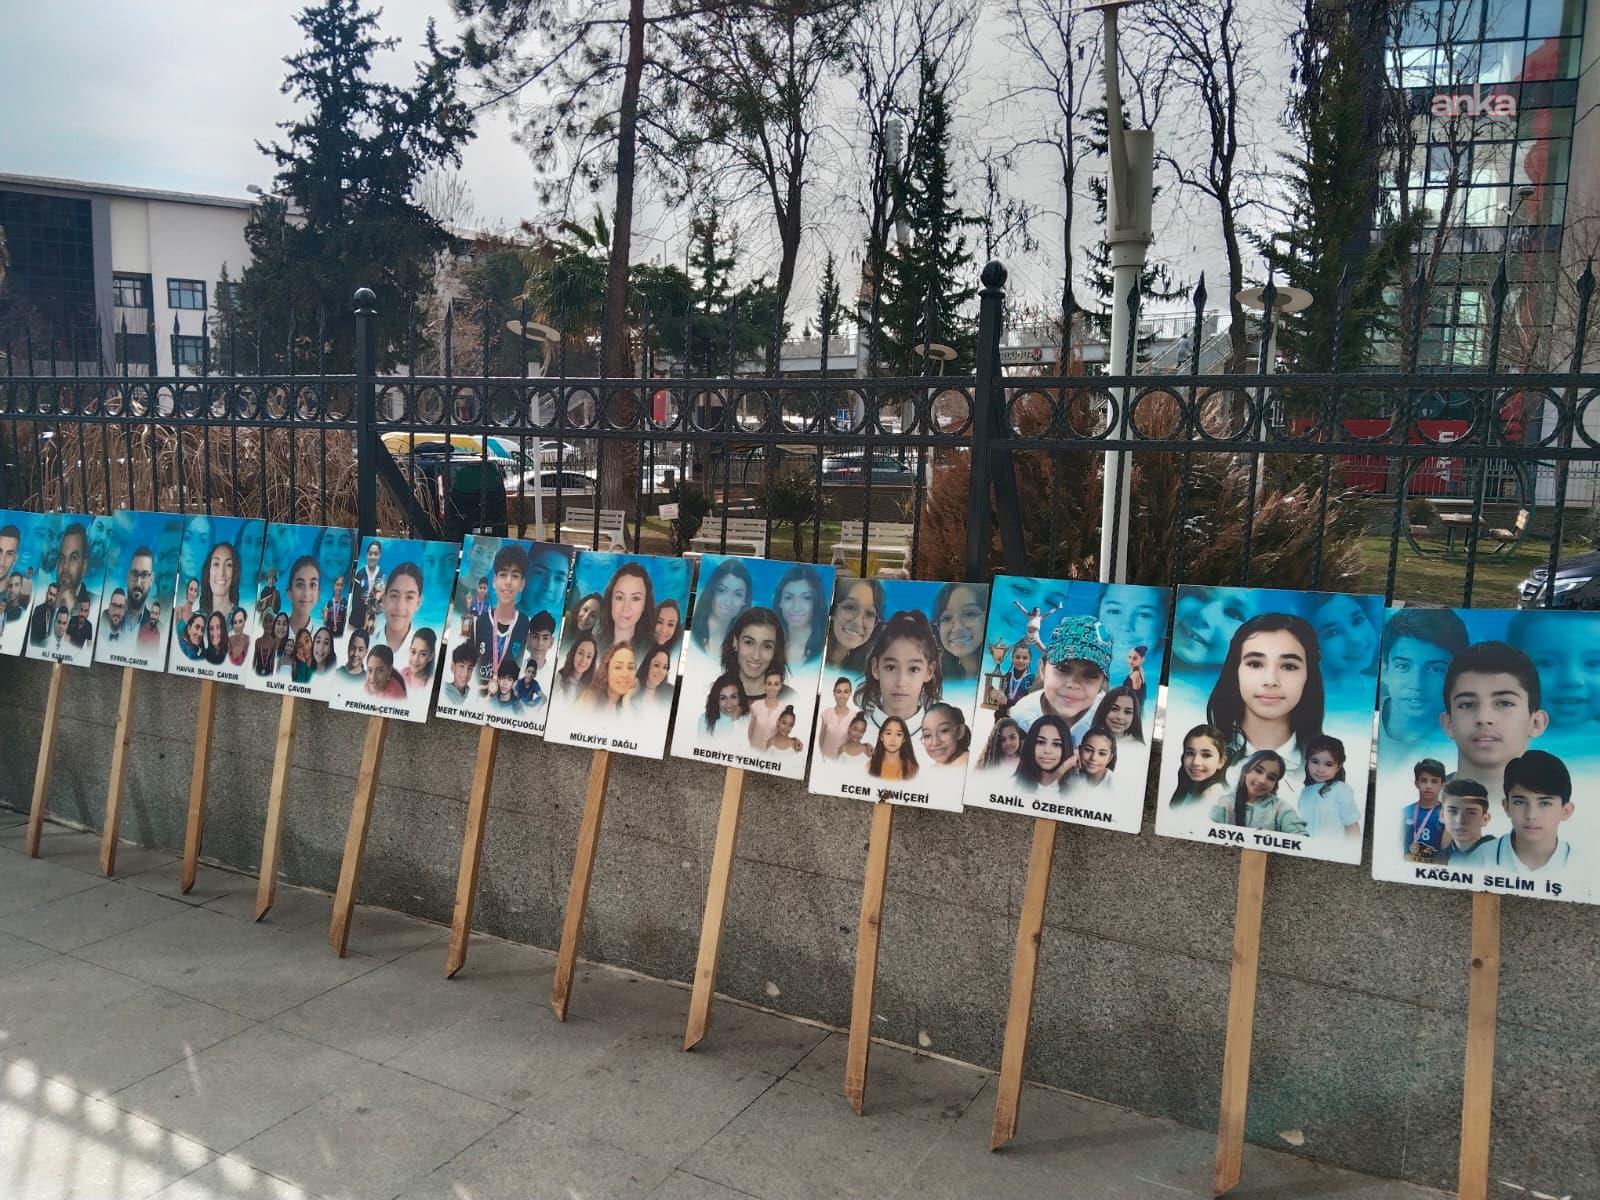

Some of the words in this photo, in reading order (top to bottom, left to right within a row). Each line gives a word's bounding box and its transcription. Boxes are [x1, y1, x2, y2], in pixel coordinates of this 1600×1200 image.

[176, 665, 196, 673] HAVVA
[217, 671, 239, 681] ÇAVDIR
[266, 680, 285, 691] ELVİN
[288, 685, 312, 695] ÇAVDIR
[345, 700, 376, 712] PERİHAN
[378, 705, 410, 717] ÇETİNER
[437, 706, 458, 715] MERT
[459, 709, 485, 721] NİYAZİ
[486, 714, 545, 732] TOPUKÇUOĞLU
[569, 732, 608, 746] MÜLKİYE
[611, 738, 638, 751] DAĞLI
[693, 747, 735, 763] BEDRİYE
[736, 755, 782, 772] YENİÇERİ
[841, 784, 871, 797] ECEM
[989, 793, 1025, 808] SAHİL
[1031, 799, 1113, 823] ÖZBERKMAN
[1208, 827, 1246, 843] ASYA
[1253, 833, 1302, 851] TÜLEK
[1421, 828, 1431, 841] 8
[1415, 867, 1474, 885] KAĞAN
[1483, 875, 1535, 892] SELİM
[1545, 879, 1563, 896] İŞ
